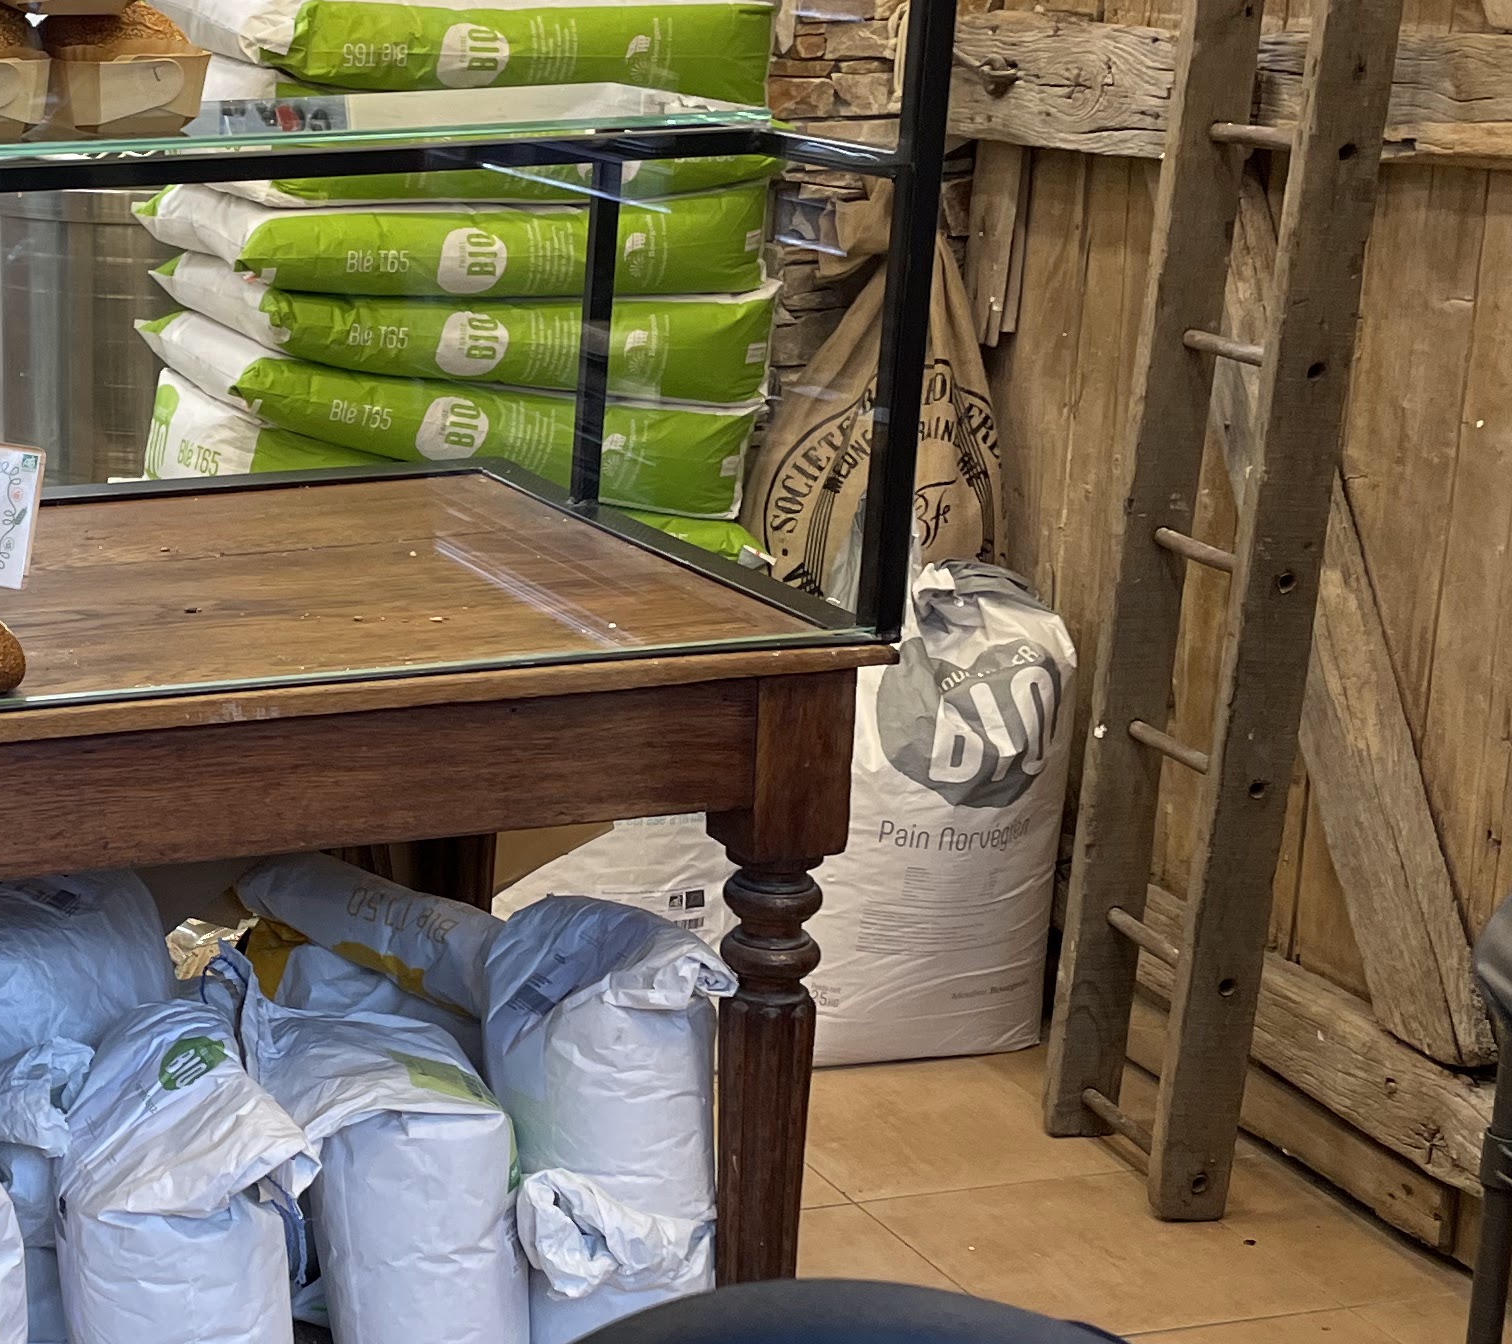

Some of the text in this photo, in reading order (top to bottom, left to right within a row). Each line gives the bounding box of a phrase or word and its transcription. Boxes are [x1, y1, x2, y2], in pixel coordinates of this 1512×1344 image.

[343, 44, 376, 67] T65
[467, 28, 499, 71] BIO
[346, 250, 409, 273] Blé T65
[466, 233, 498, 277] BIO
[348, 324, 410, 349] Blé T65
[466, 317, 499, 361] BIO
[329, 399, 394, 431] Blé T65
[444, 403, 482, 448] BIO
[177, 438, 222, 477] Blé T65
[878, 819, 930, 850] Pain
[165, 1047, 208, 1089] BIO
